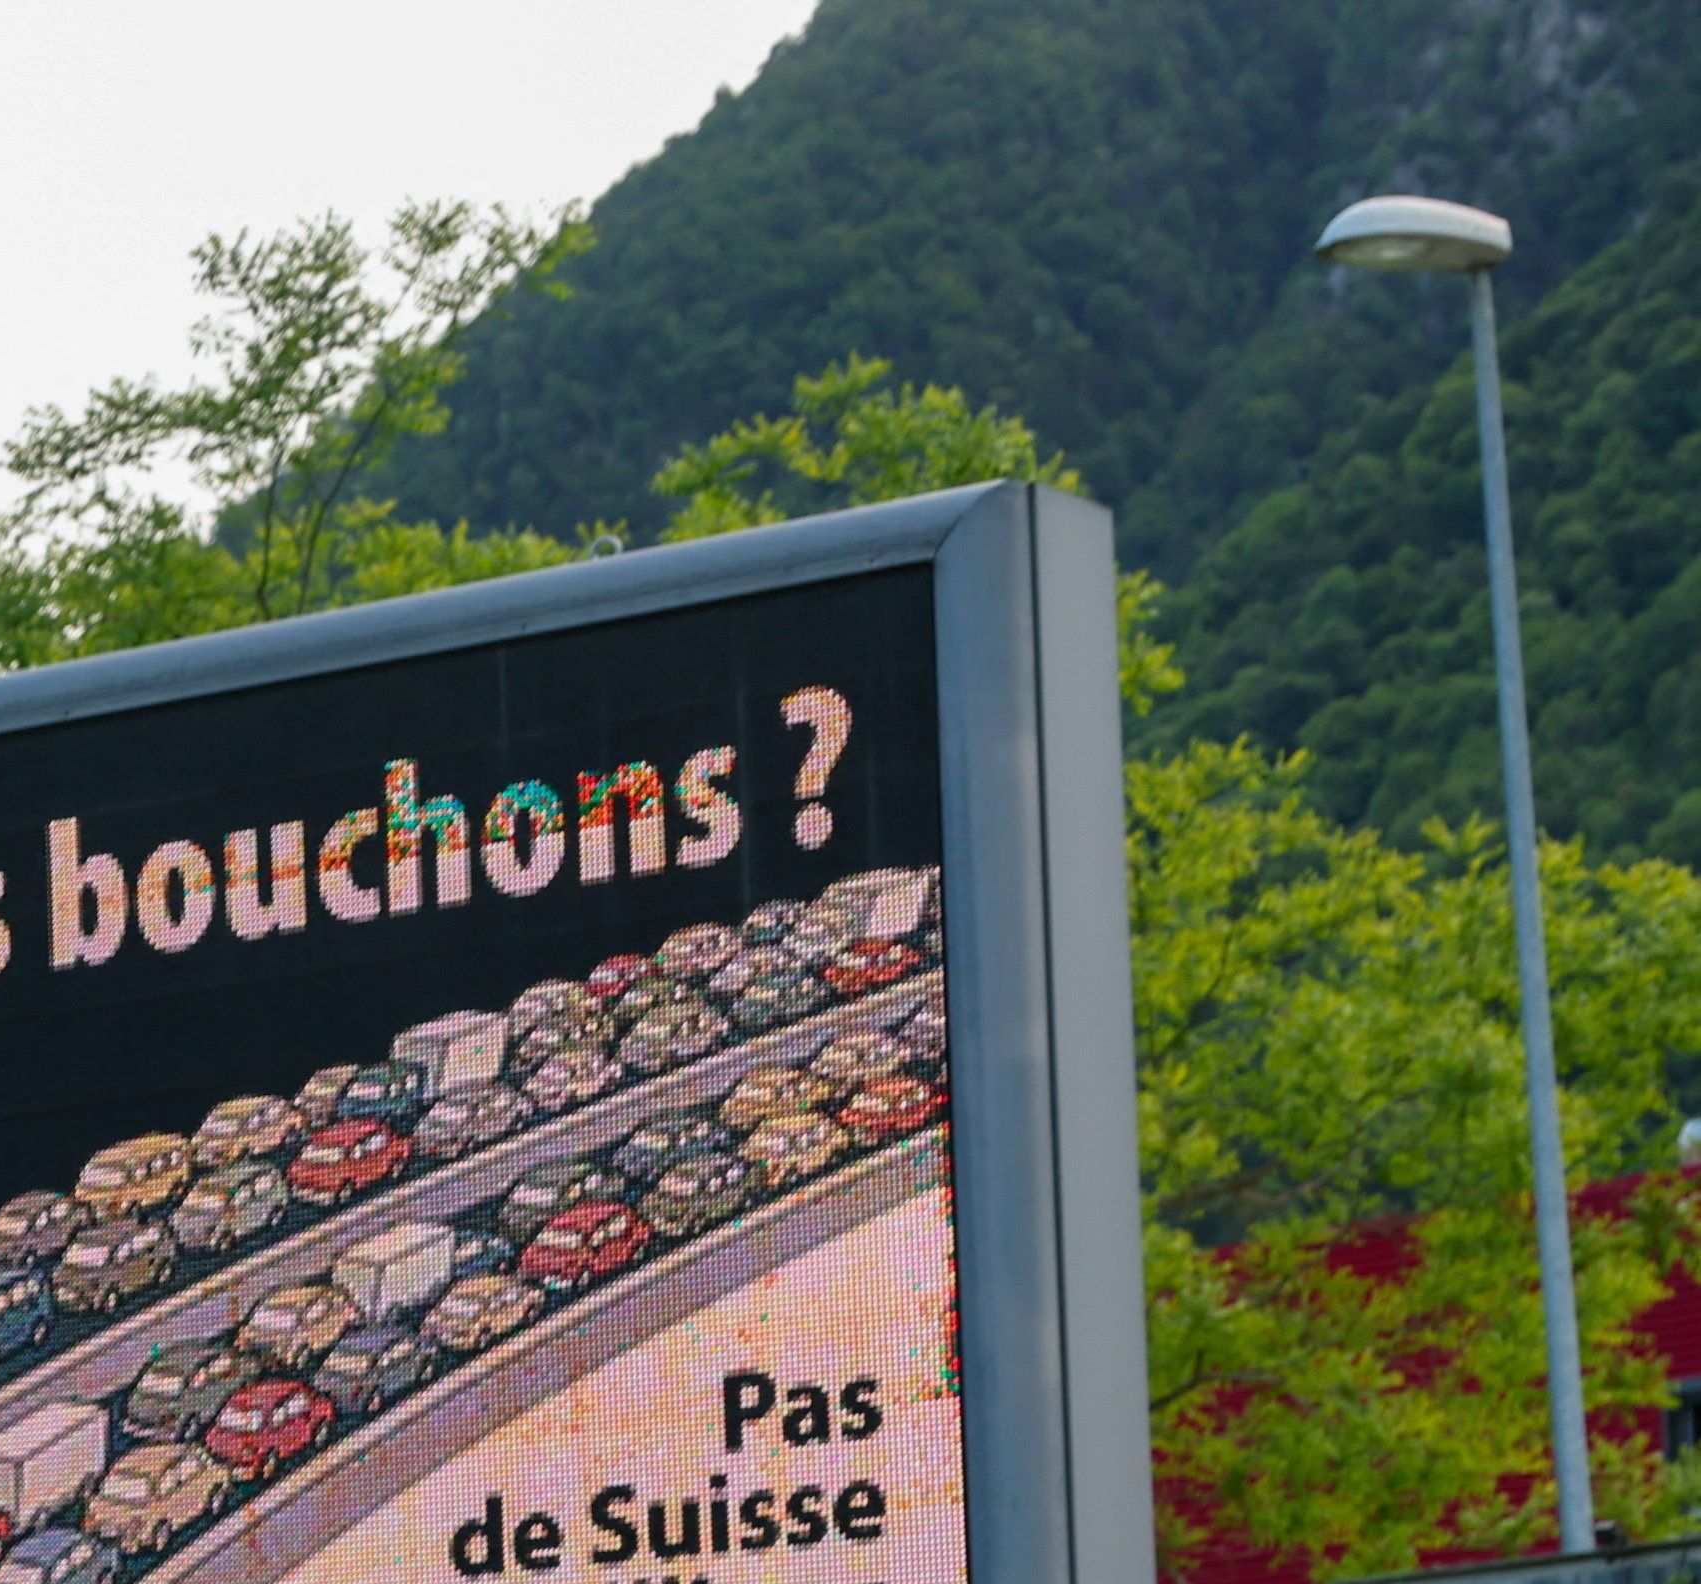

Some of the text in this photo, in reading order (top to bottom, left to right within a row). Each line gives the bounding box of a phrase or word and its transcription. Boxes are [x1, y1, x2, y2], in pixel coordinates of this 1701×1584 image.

[47, 745, 741, 971] bouchons
[780, 685, 853, 851] ?
[723, 1371, 883, 1454] Pas
[451, 1474, 886, 1577] de Suisse
